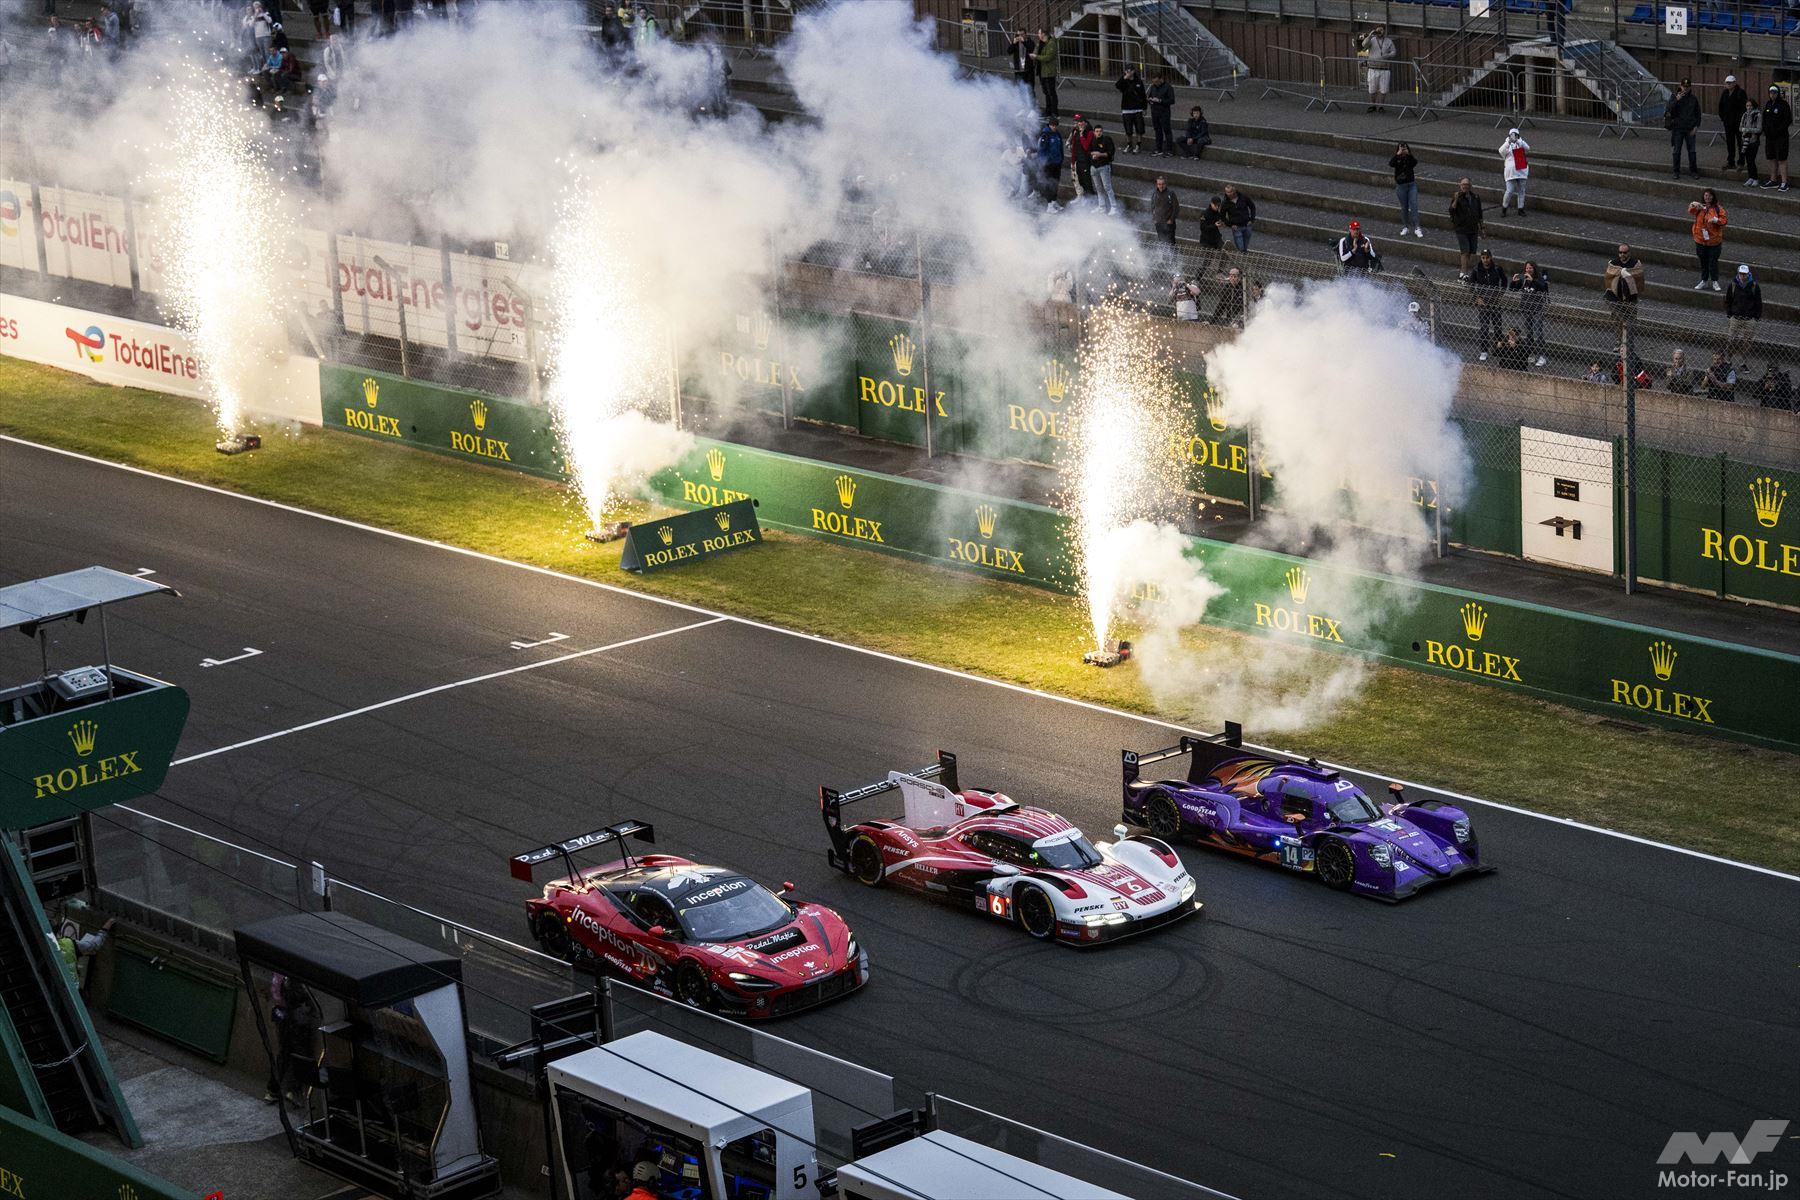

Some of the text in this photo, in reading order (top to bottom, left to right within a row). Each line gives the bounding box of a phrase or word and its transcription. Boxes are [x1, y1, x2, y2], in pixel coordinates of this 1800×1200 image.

[859, 376, 949, 417] ROLEX
[345, 408, 402, 437] ROLEX
[450, 431, 512, 461] ROLEX
[811, 508, 885, 543] ROLEX
[644, 529, 756, 567] ROLEX ROLEX
[948, 538, 1025, 573] ROLEX
[1254, 603, 1344, 643] ROLEX
[1425, 640, 1523, 682] ROLEX
[1611, 679, 1715, 723] ROLEX
[33, 751, 142, 798] ROLEX
[1182, 803, 1217, 816] GOODYEAR
[1283, 845, 1299, 864] 14
[686, 881, 748, 905] inception
[1126, 881, 1143, 892] 6
[992, 896, 1003, 915] 6
[1073, 904, 1105, 914] PENSKE
[571, 904, 636, 958] inception
[769, 943, 820, 964] inception
[793, 1164, 807, 1190] 5
